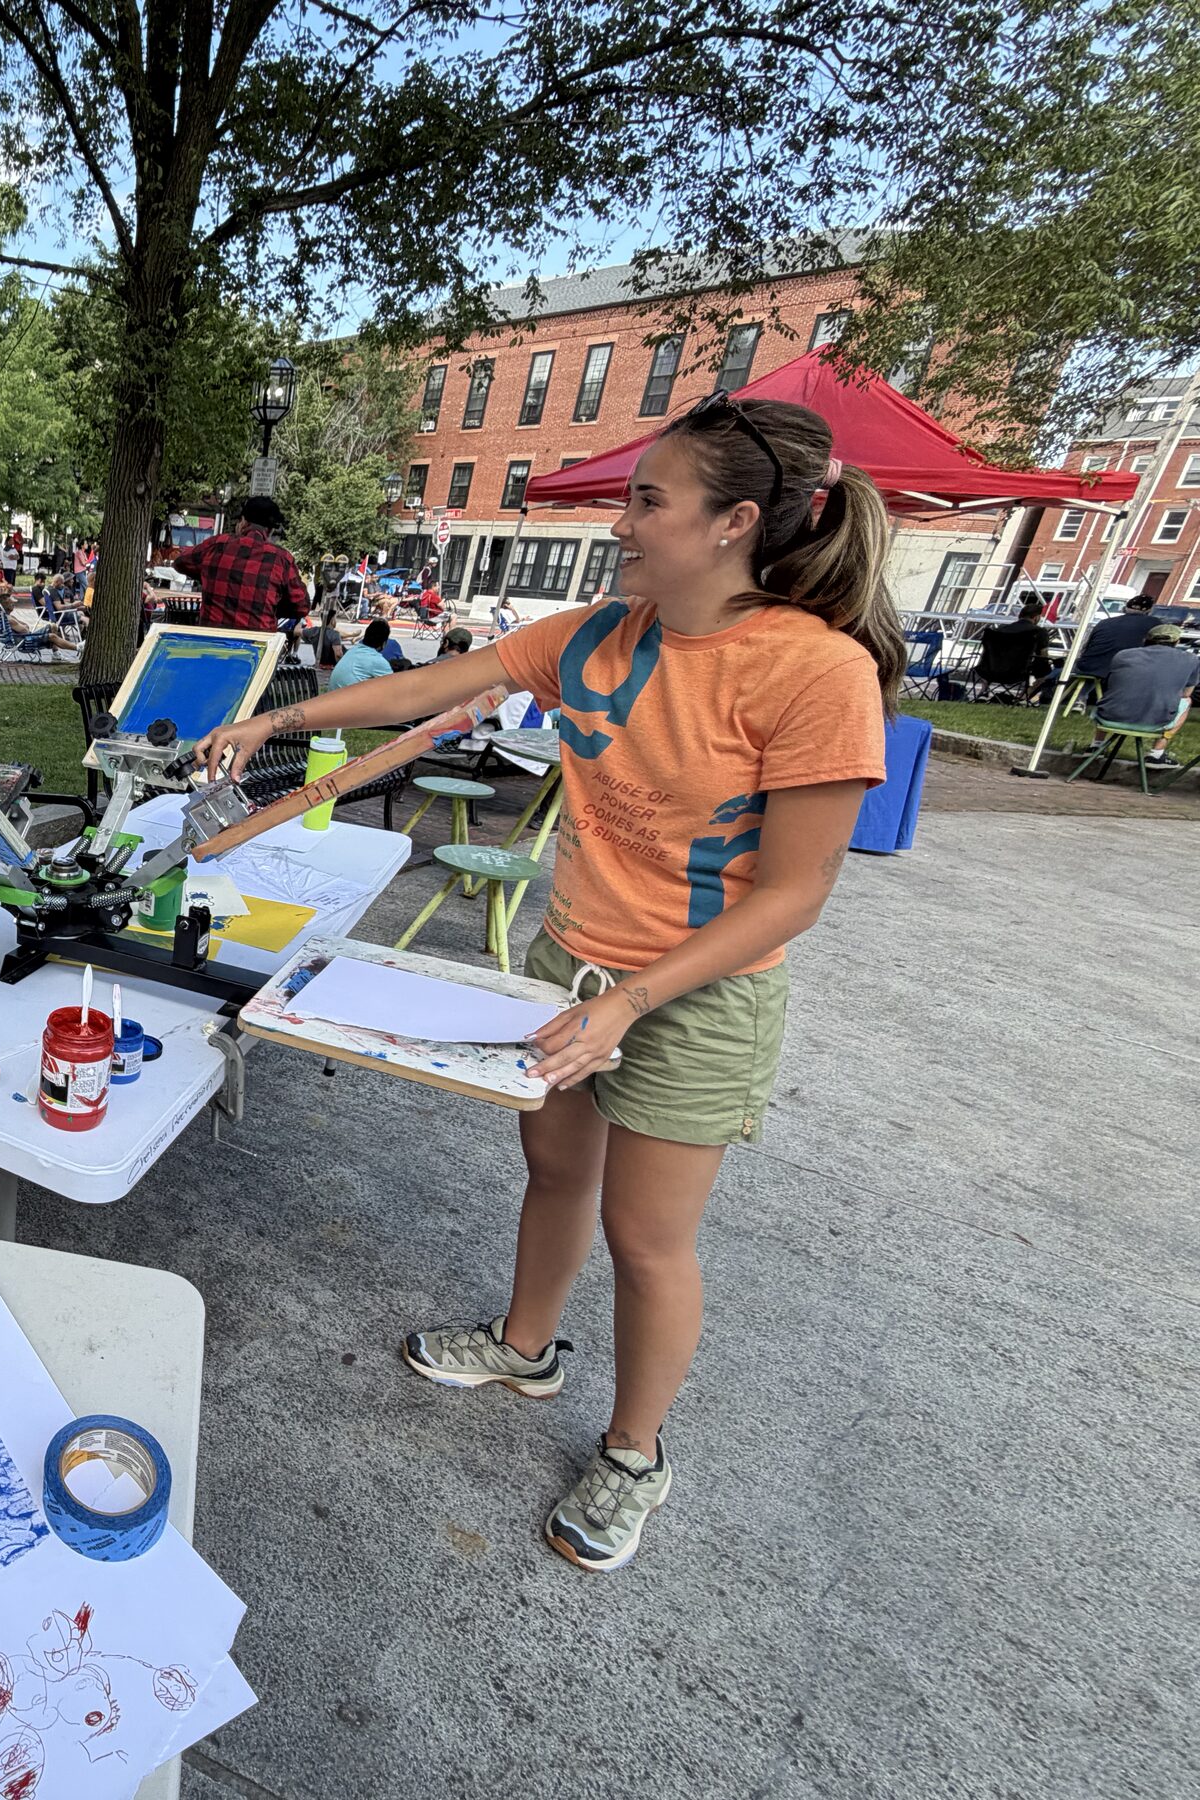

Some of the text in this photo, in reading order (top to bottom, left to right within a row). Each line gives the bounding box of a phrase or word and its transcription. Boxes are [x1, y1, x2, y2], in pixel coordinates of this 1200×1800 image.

[592, 771, 675, 805] ABUSE OF
[583, 803, 634, 833] COMES
[636, 826, 662, 842] AS
[600, 792, 657, 821] POWER
[591, 826, 673, 862] SURPRISE
